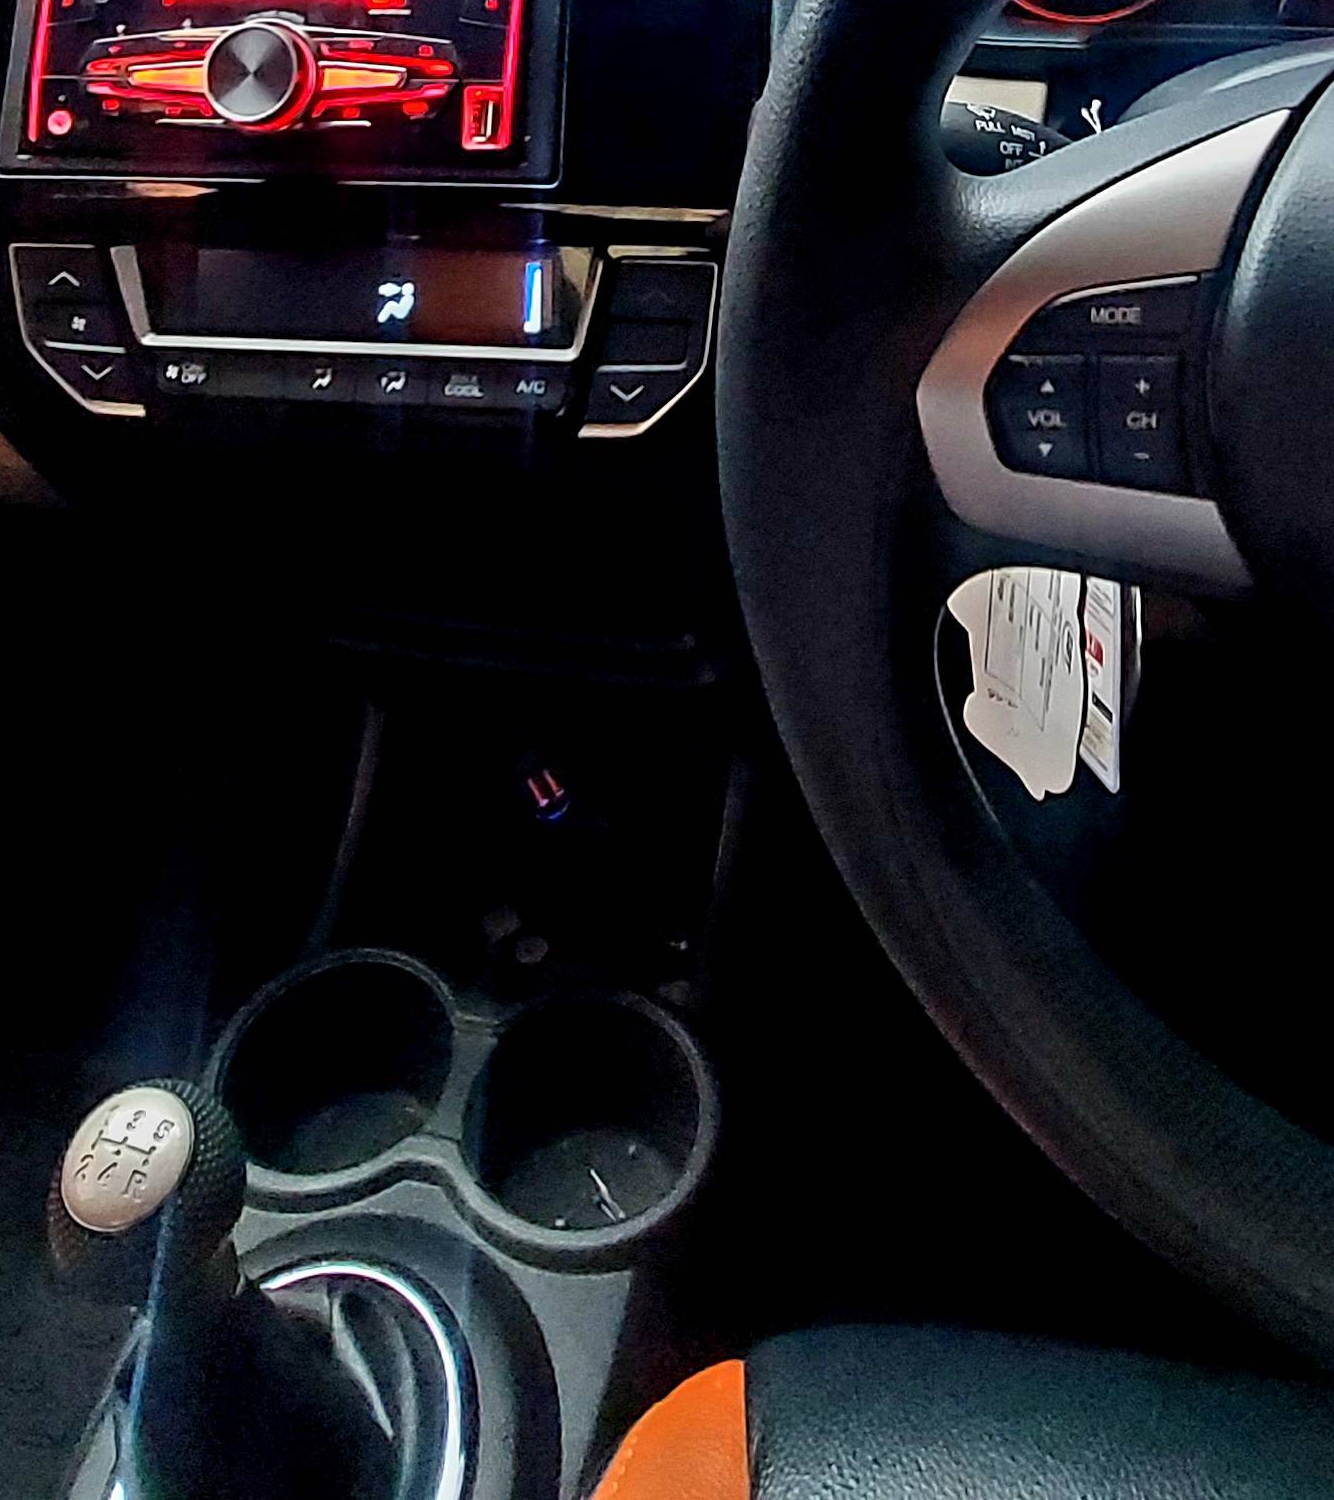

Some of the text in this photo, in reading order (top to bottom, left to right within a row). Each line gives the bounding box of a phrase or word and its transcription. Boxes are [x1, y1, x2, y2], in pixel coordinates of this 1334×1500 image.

[975, 119, 1006, 134] PULL
[999, 141, 1024, 156] OFF
[1090, 307, 1142, 324] MODE
[515, 379, 546, 395] A/C
[1026, 410, 1066, 428] VOL
[1126, 411, 1158, 430] CH
